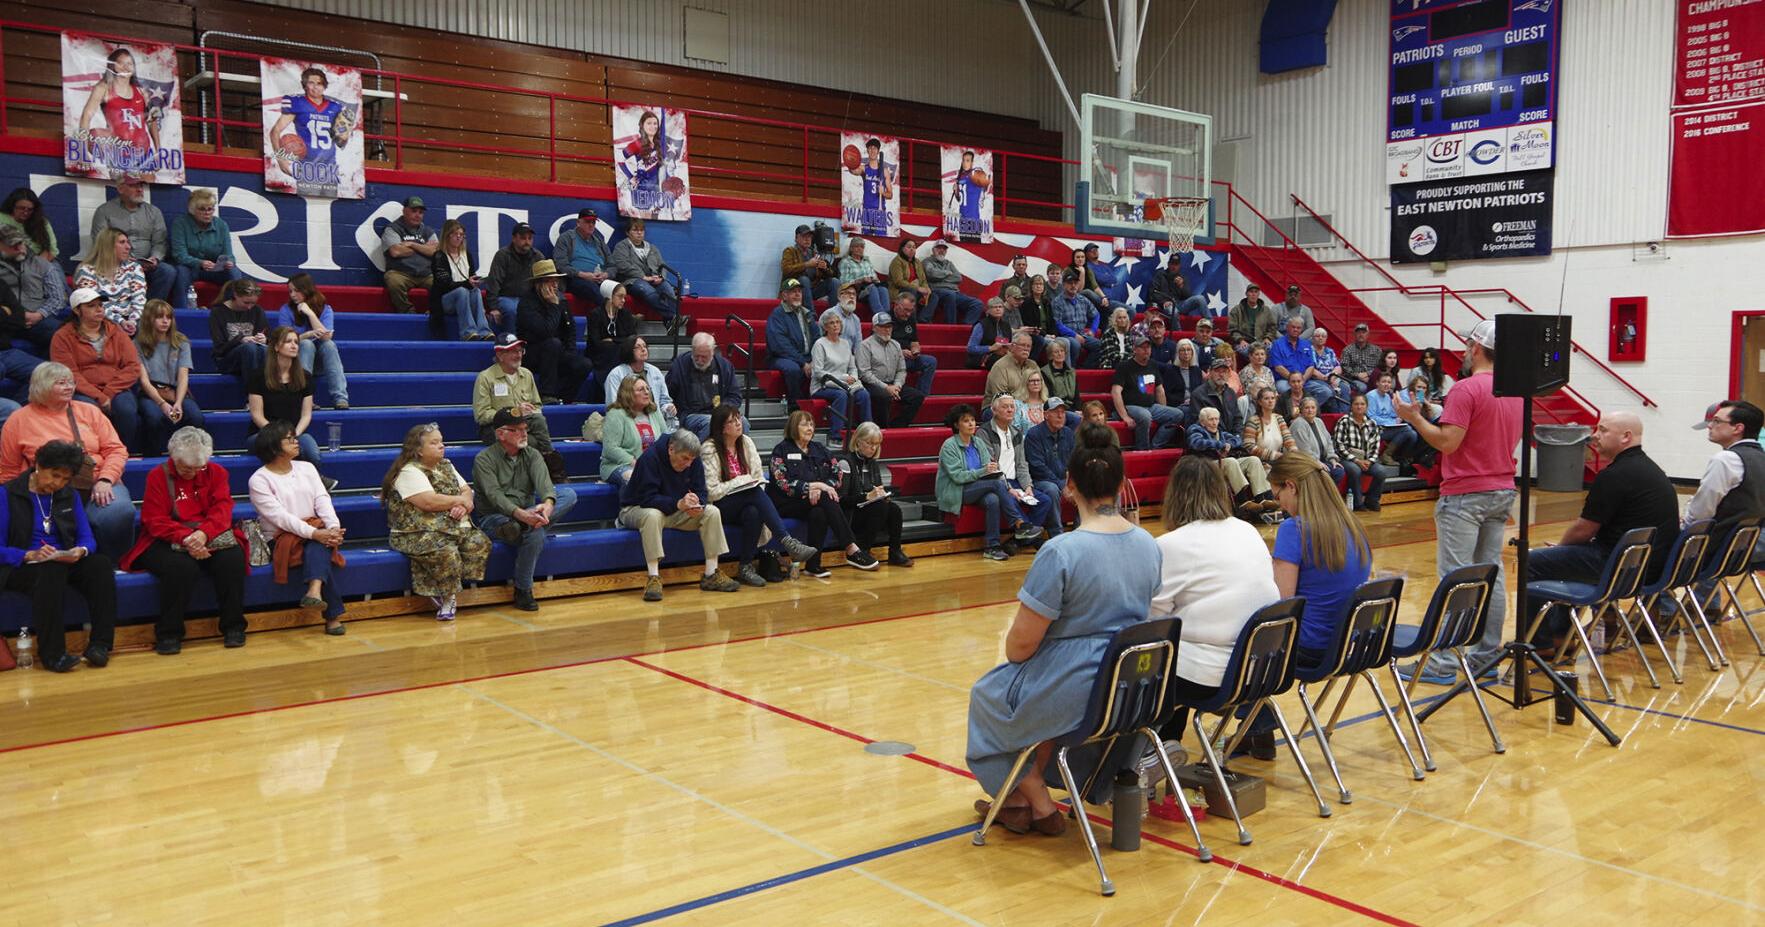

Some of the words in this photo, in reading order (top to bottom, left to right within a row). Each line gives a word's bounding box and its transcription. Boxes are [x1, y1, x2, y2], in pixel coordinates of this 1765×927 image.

[1708, 21, 1722, 30] BIG
[1504, 24, 1547, 44] GUEST
[1709, 32, 1723, 42] BIG
[1392, 44, 1445, 64] PATRIOTS
[1453, 44, 1483, 57] PERIOD
[1709, 45, 1722, 55] BIG
[1686, 58, 1708, 69] 2007
[1708, 51, 1743, 65] DISTRICT
[1708, 66, 1721, 76] BIG
[1732, 58, 1765, 72] DISTRICT
[1520, 72, 1549, 86] FOULS
[1722, 70, 1748, 82] PLACE
[1748, 66, 1765, 78] STA
[1440, 84, 1472, 98] PLAYER
[1473, 81, 1495, 94] FOUL
[1708, 85, 1720, 95] BIG
[1733, 77, 1765, 91] DISTRICT
[1722, 89, 1748, 101] PLACE
[1749, 85, 1765, 97] STA
[1391, 93, 1417, 106] FOULS
[1519, 109, 1548, 122] SCORE
[1684, 115, 1702, 126] 2014
[1703, 111, 1739, 123] DISTRICT
[1451, 119, 1480, 131] MATCH
[1703, 121, 1750, 136] CONFERENCE
[76, 129, 134, 149] Brooklyn
[306, 119, 333, 150] 15
[1391, 127, 1416, 140] SCORE
[1513, 129, 1544, 141] Silver
[1432, 139, 1463, 158] CBT
[1521, 139, 1550, 150] Moon
[68, 138, 182, 172] BLANCHARD
[292, 160, 341, 185] COOK
[1426, 165, 1462, 174] Community
[1416, 186, 1453, 200] PROUDLY
[1453, 181, 1506, 196] SUPPORTING
[1507, 179, 1525, 190] THE
[1397, 203, 1427, 216] EAST
[1428, 197, 1482, 213] NEWTON
[1484, 192, 1545, 208] PATRIOTS
[846, 207, 894, 227] WALTERS
[1502, 219, 1537, 232] FREEMAN
[1482, 243, 1489, 251] &
[1489, 242, 1508, 252] Sports
[1508, 241, 1536, 250] Medicine
[1495, 233, 1536, 245] Orthopaedics
